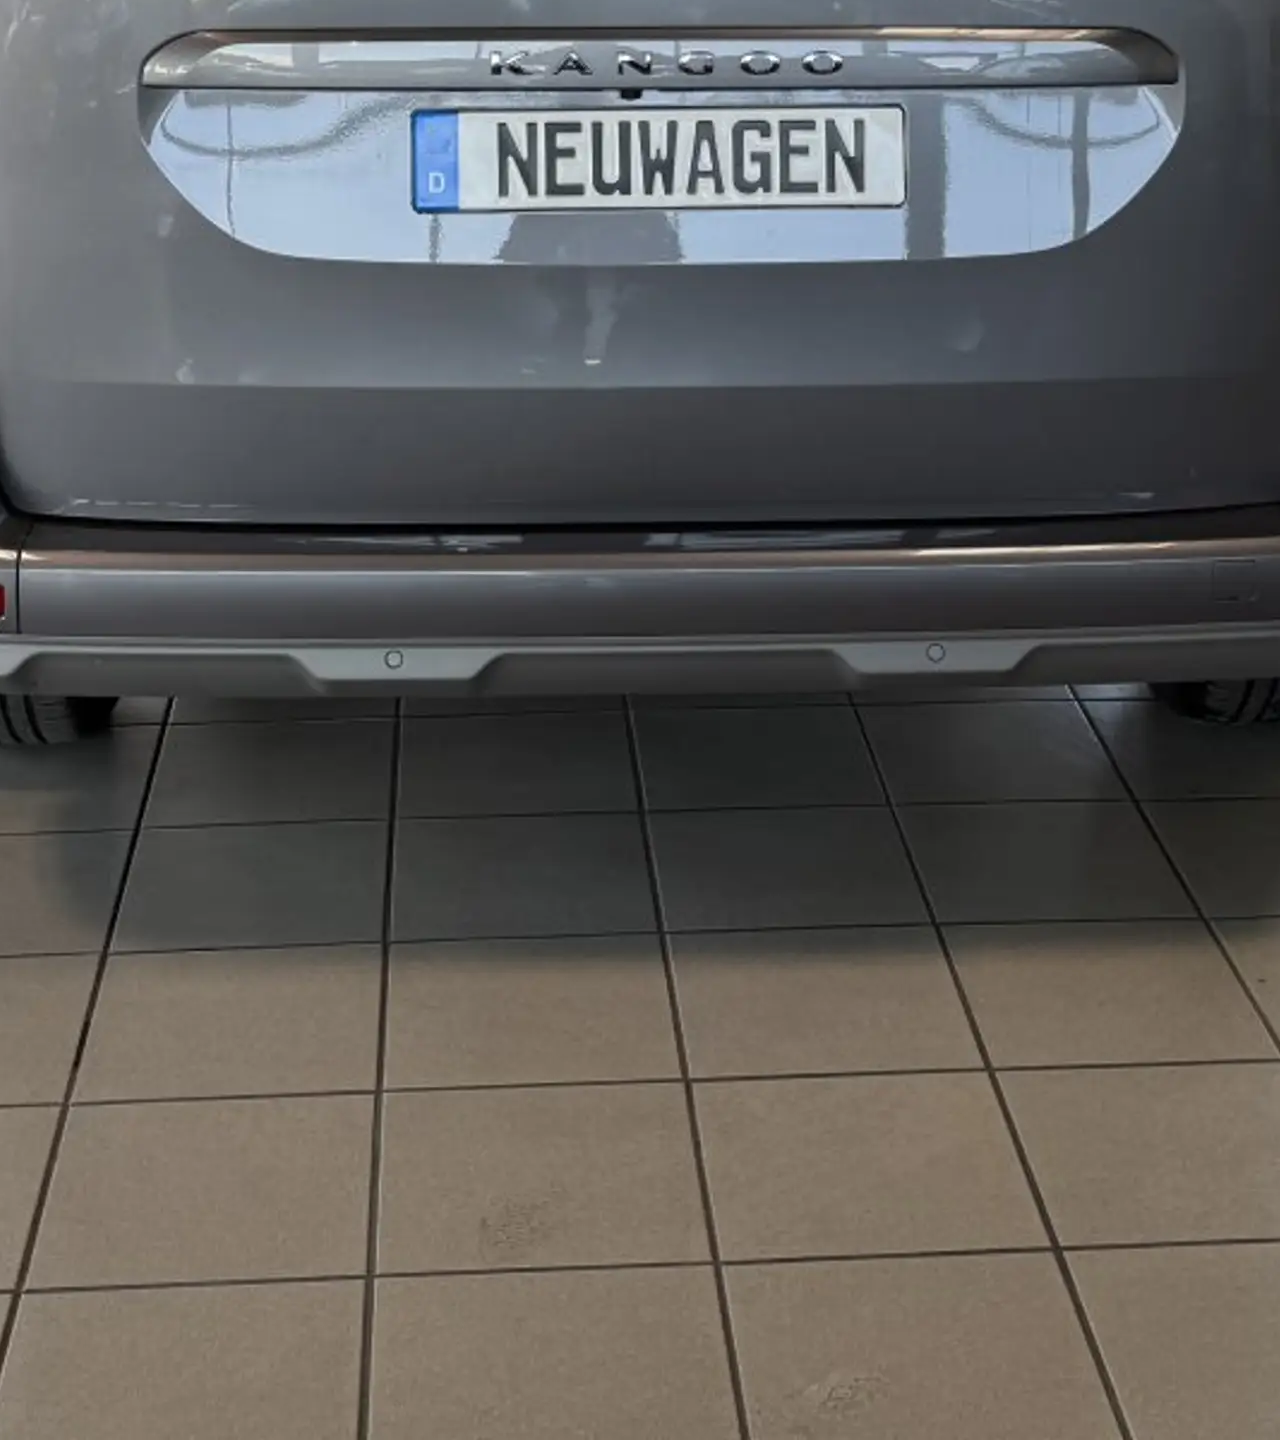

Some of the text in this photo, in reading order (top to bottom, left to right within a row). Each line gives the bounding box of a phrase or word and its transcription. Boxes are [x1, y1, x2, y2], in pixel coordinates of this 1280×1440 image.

[488, 50, 844, 77] KANGOO
[496, 117, 866, 198] NEUWAGEN
[428, 171, 446, 194] D
